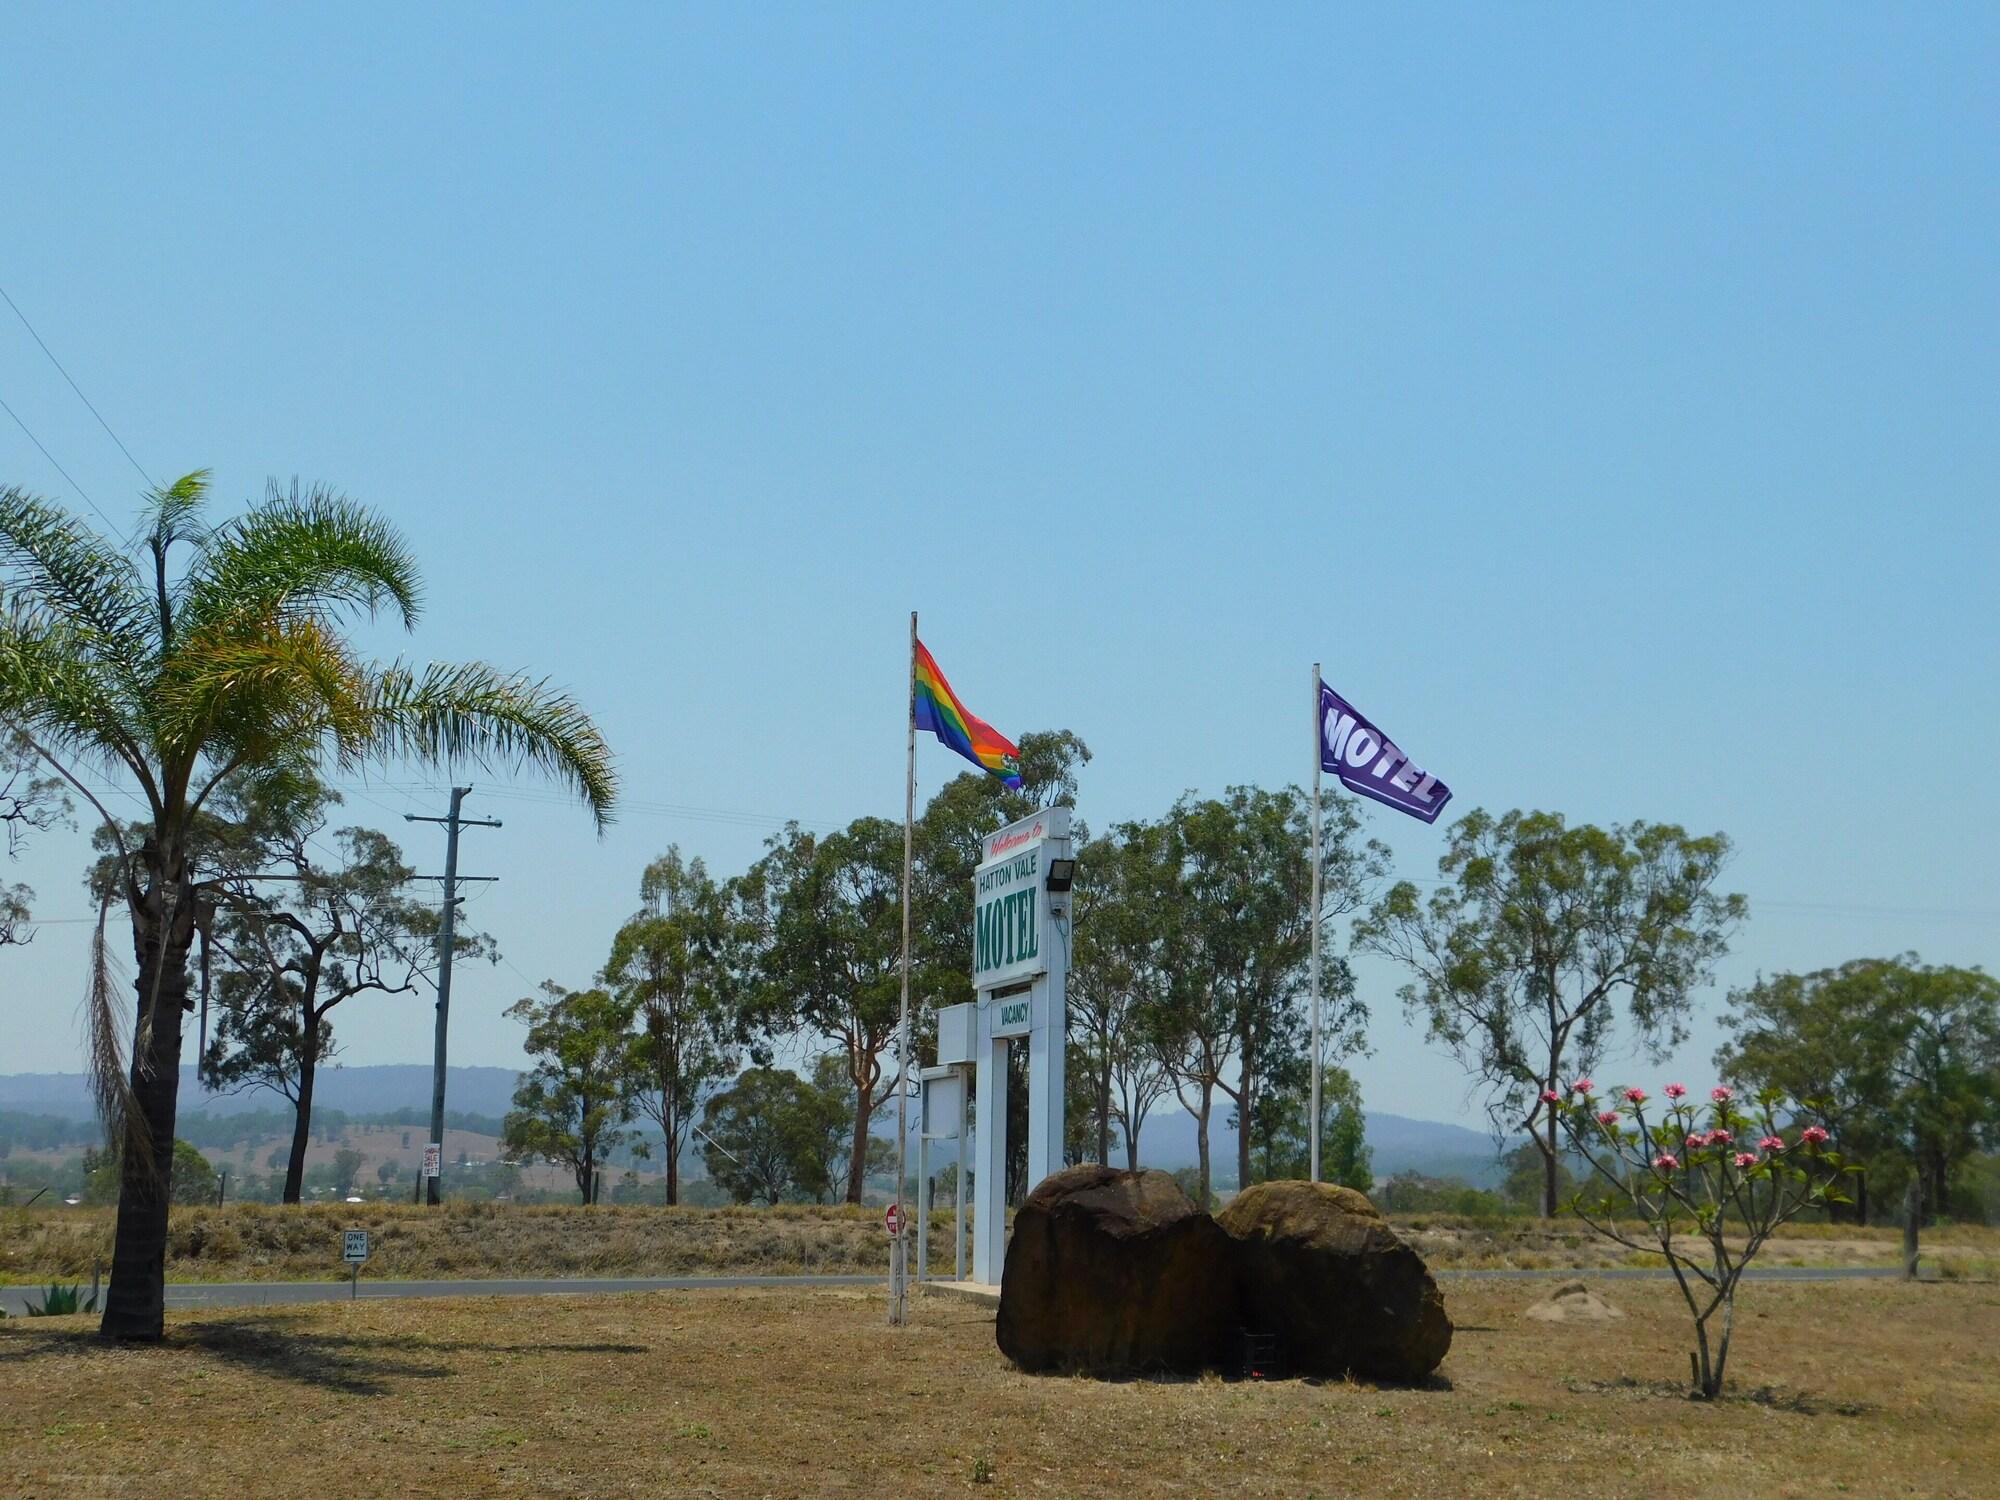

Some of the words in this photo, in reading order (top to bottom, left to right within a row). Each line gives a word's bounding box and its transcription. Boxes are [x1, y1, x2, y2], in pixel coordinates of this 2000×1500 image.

[1324, 707, 1438, 803] MOTEL
[990, 831, 1030, 858] Welcome
[1032, 821, 1042, 839] to
[980, 865, 1012, 895] HATTON
[1014, 854, 1037, 881] VALE
[976, 886, 1039, 973] MOTEL
[1001, 1002, 1029, 1026] VACANCY
[347, 1233, 365, 1241] ONE
